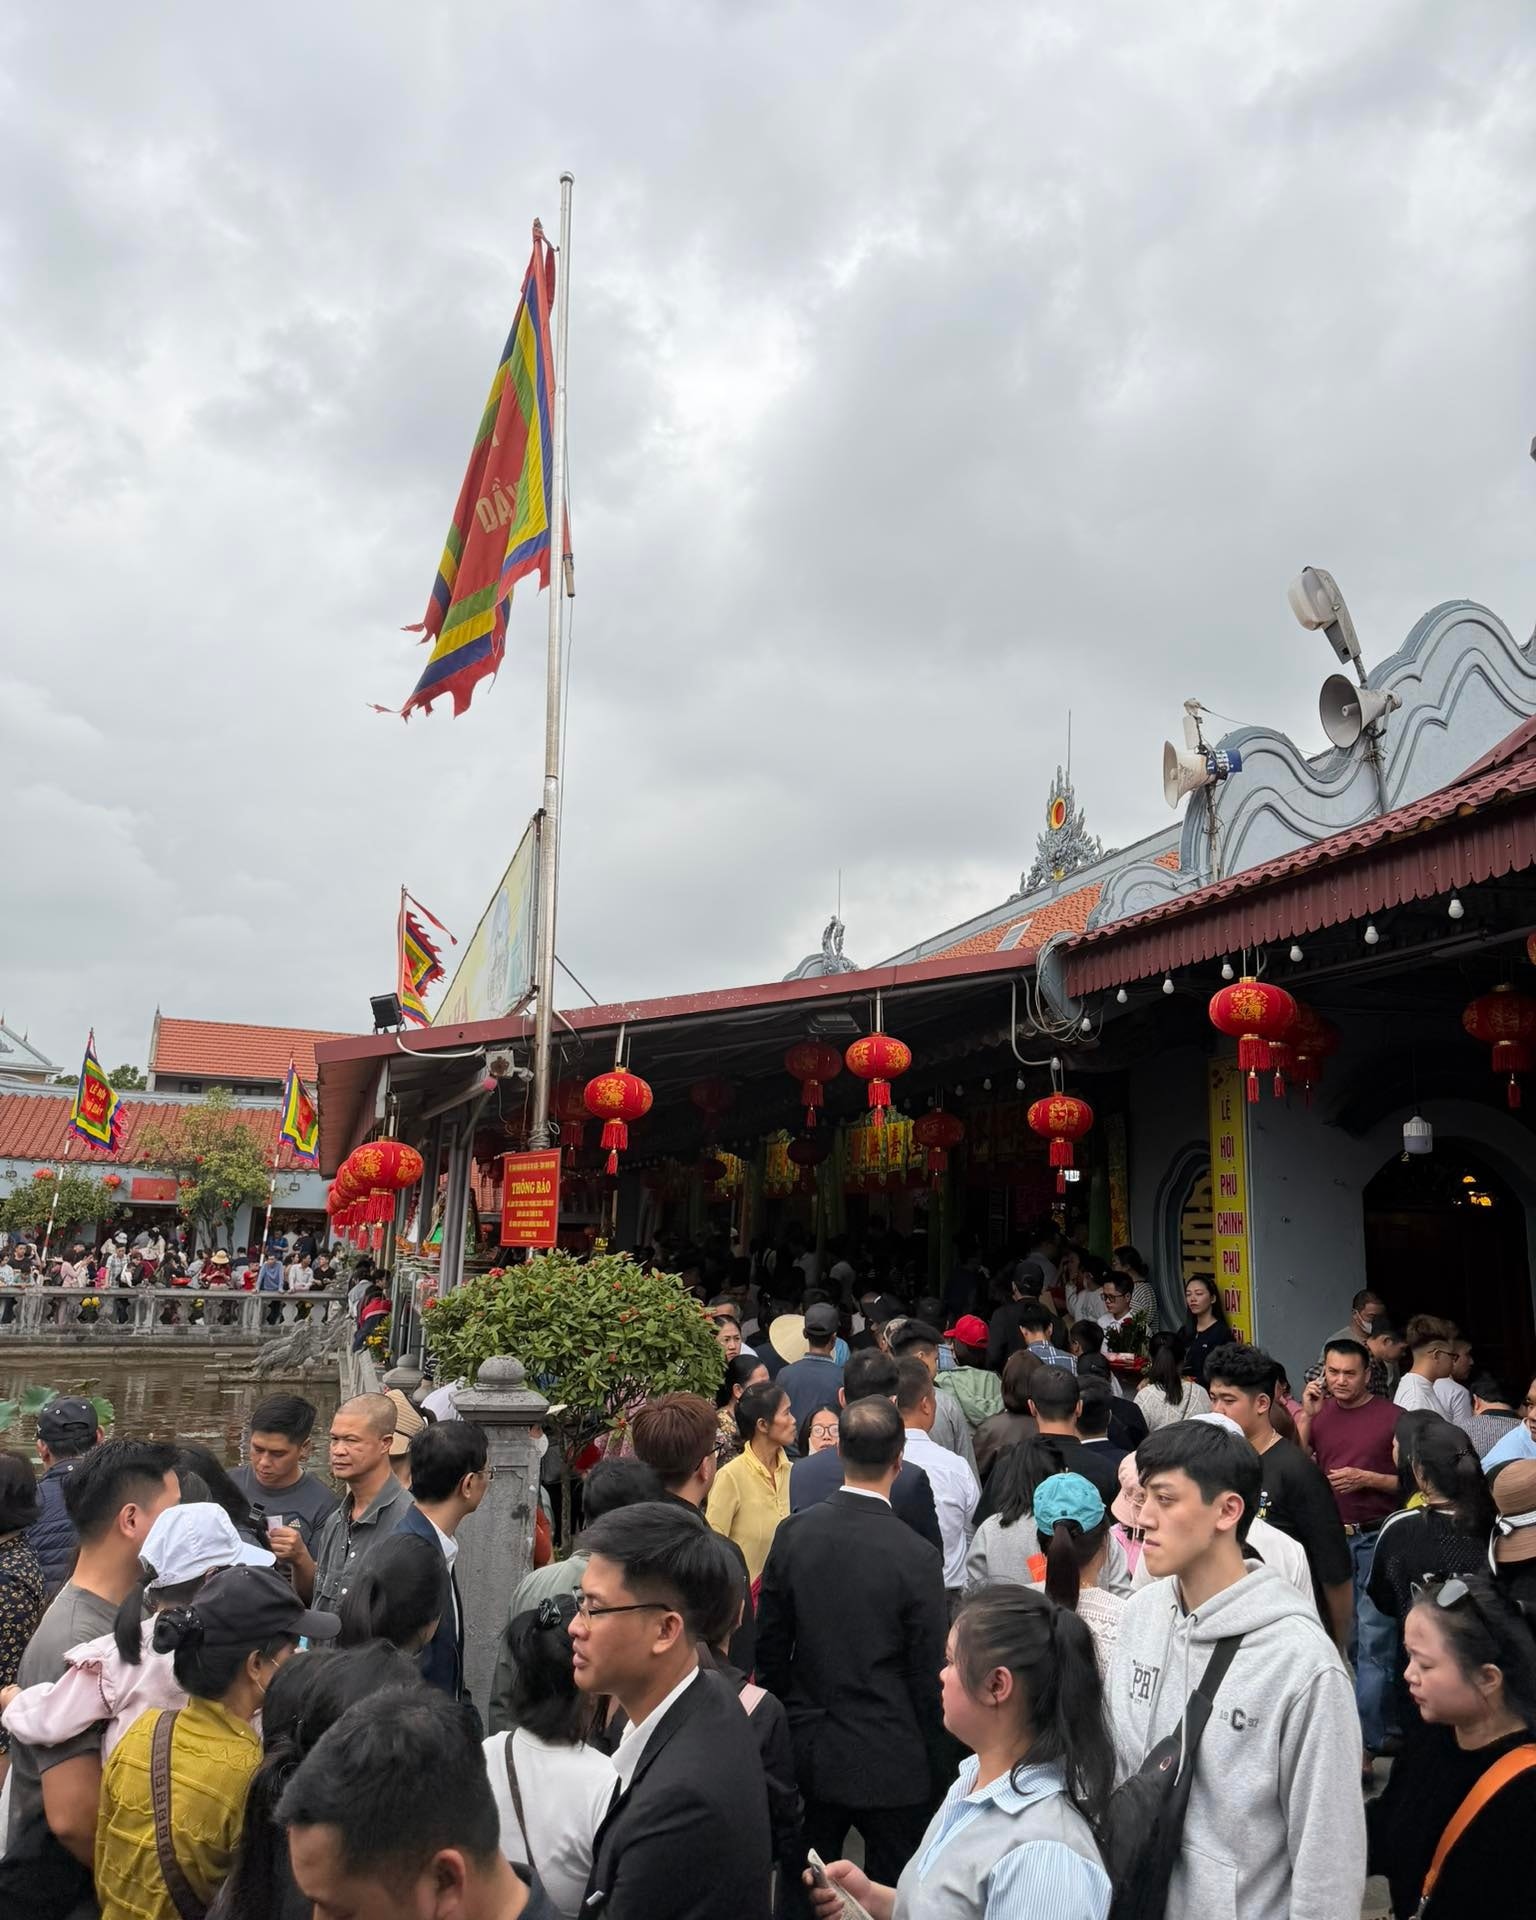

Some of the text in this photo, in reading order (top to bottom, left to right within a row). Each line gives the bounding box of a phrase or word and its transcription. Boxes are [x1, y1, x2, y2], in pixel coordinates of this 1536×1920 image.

[1220, 1132, 1235, 1163] HỘI
[512, 1177, 551, 1194] THÔNG BÁO
